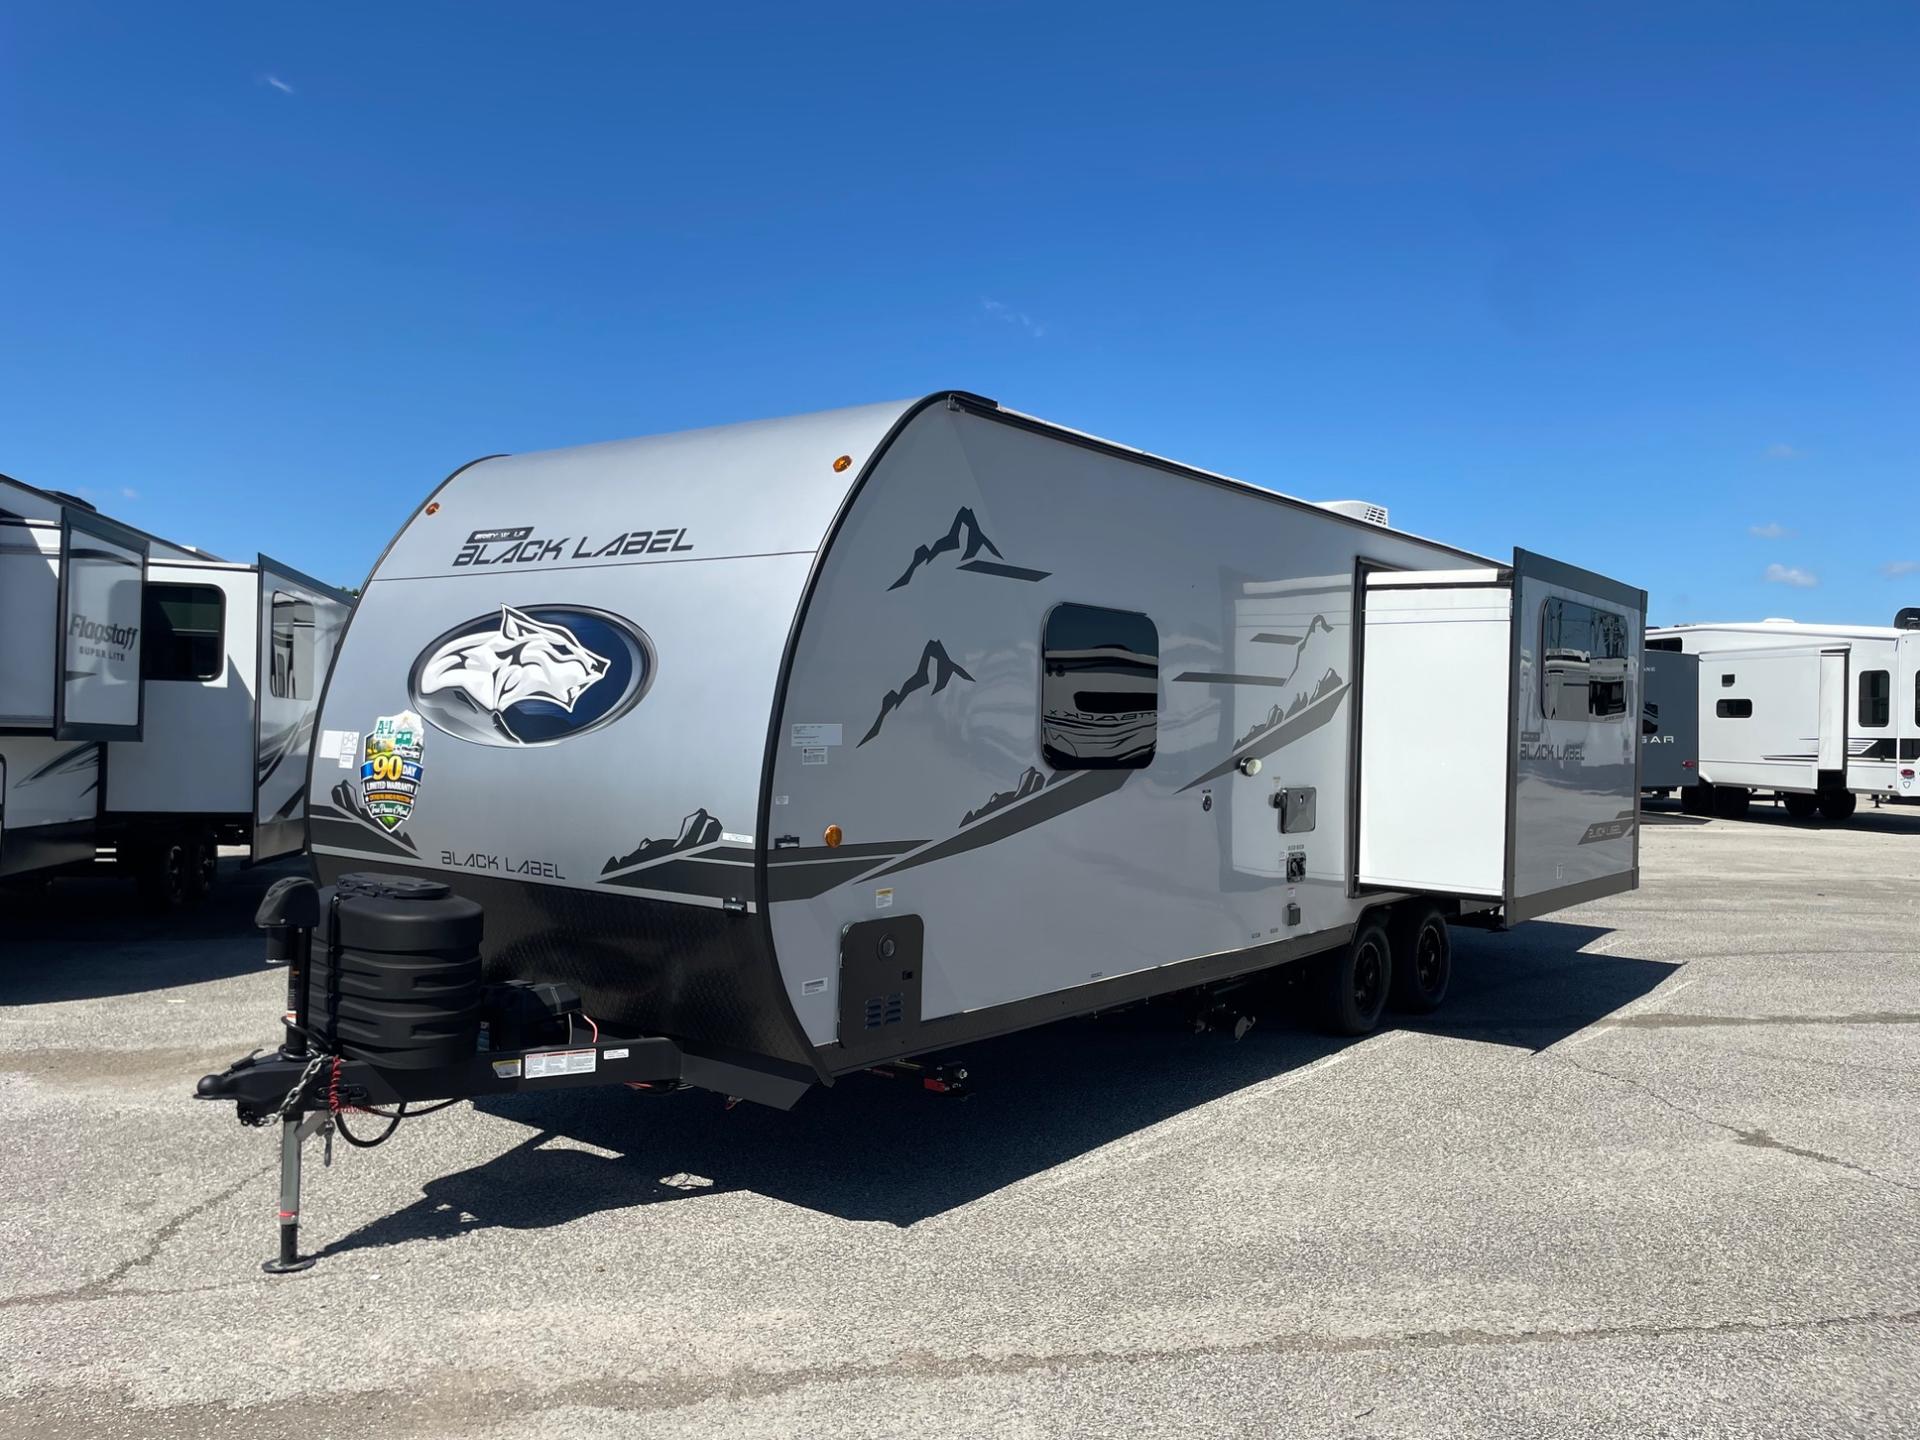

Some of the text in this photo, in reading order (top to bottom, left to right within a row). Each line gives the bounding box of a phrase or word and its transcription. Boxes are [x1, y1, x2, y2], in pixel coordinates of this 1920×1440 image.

[452, 527, 695, 567] BLACK LABEL
[69, 612, 138, 651] Flagstaff
[79, 645, 125, 662] SUPER LITE
[1520, 743, 1585, 761] BLACK LABEL
[373, 755, 417, 780] 90 DAY
[440, 850, 566, 880] BLACK LABEL
